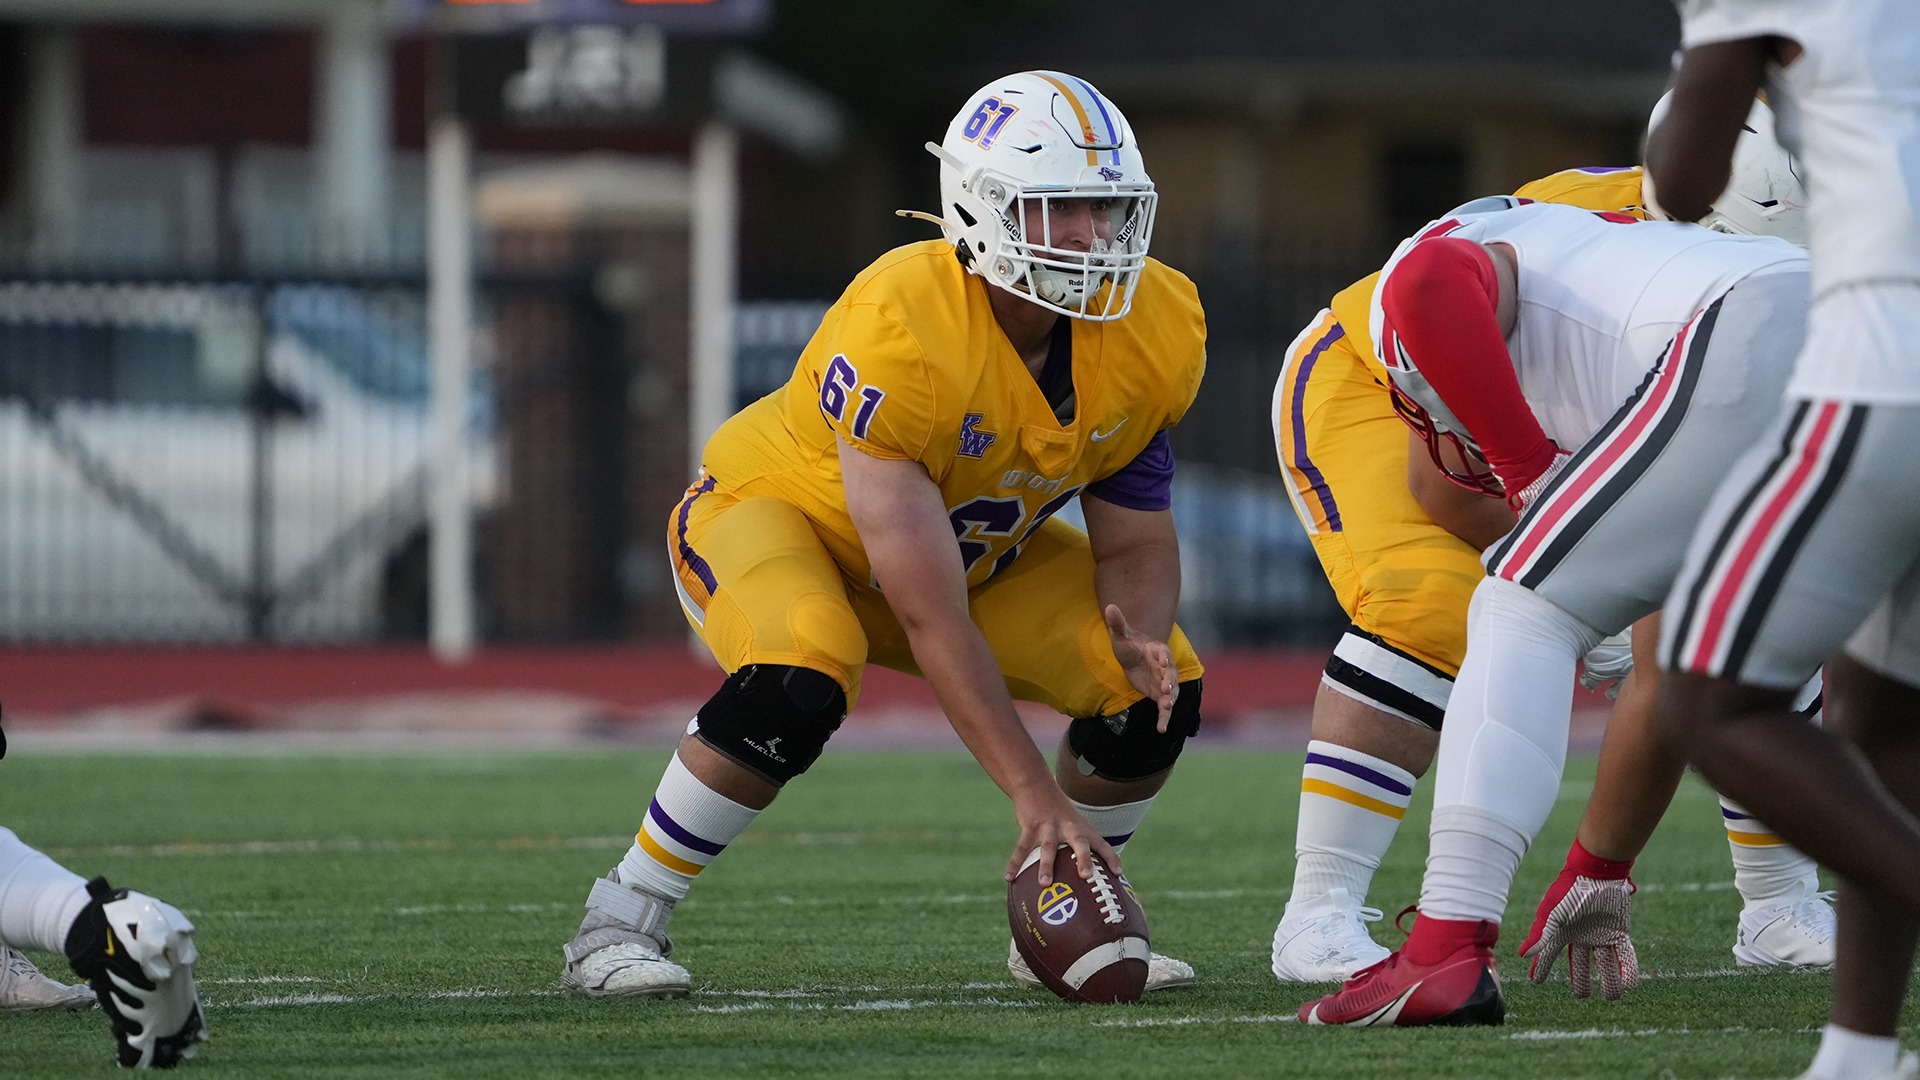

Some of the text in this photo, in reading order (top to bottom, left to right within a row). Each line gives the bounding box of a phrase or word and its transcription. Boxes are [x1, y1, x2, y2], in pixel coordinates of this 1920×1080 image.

[962, 95, 1020, 151] 61
[820, 352, 887, 440] 61
[743, 737, 786, 761] MUELLER
[1032, 926, 1048, 948] SSUE
